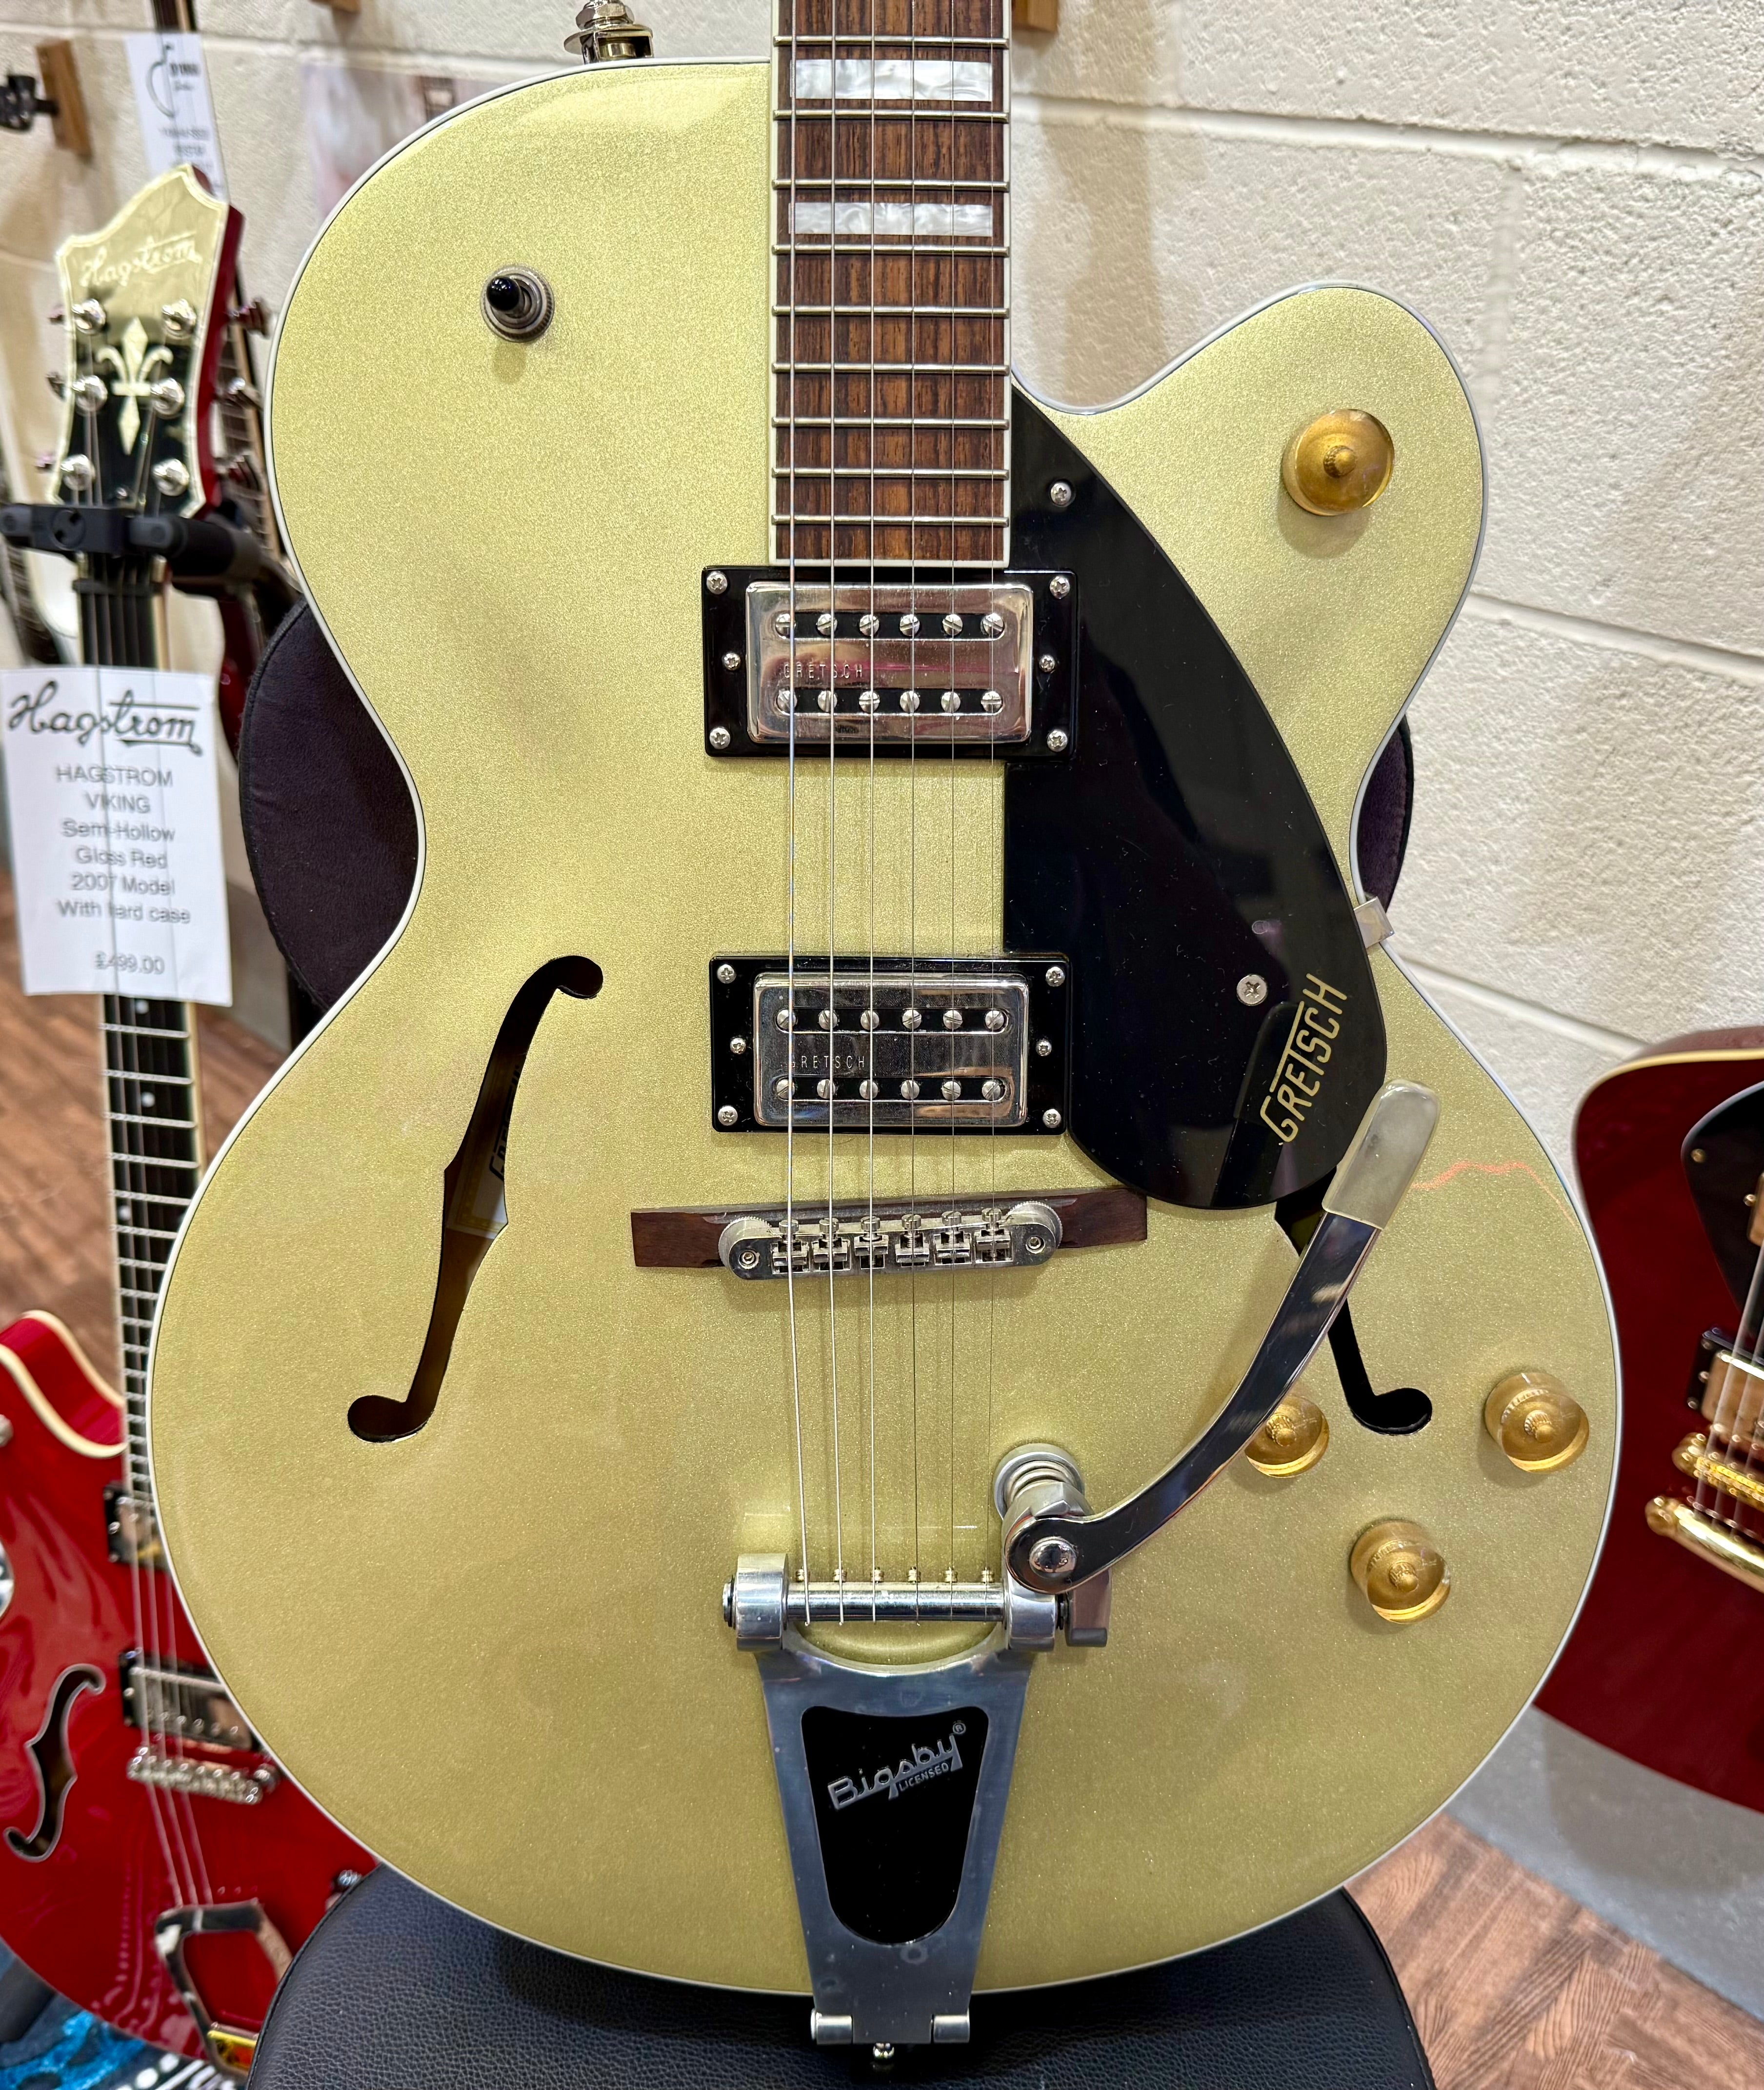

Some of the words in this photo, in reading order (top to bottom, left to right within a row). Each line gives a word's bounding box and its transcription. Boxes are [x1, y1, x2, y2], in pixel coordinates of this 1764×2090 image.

[784, 662, 862, 679] GRETSCH
[8, 680, 203, 756] Hagstrom
[57, 764, 173, 787] HAGSTROM
[76, 845, 126, 866] Gloss
[130, 847, 167, 869] Red
[121, 875, 175, 896] Model
[57, 899, 101, 917] With
[148, 906, 191, 924] case
[1260, 973, 1347, 1142] GRETSCH
[899, 1762, 949, 1791] LICENSED
